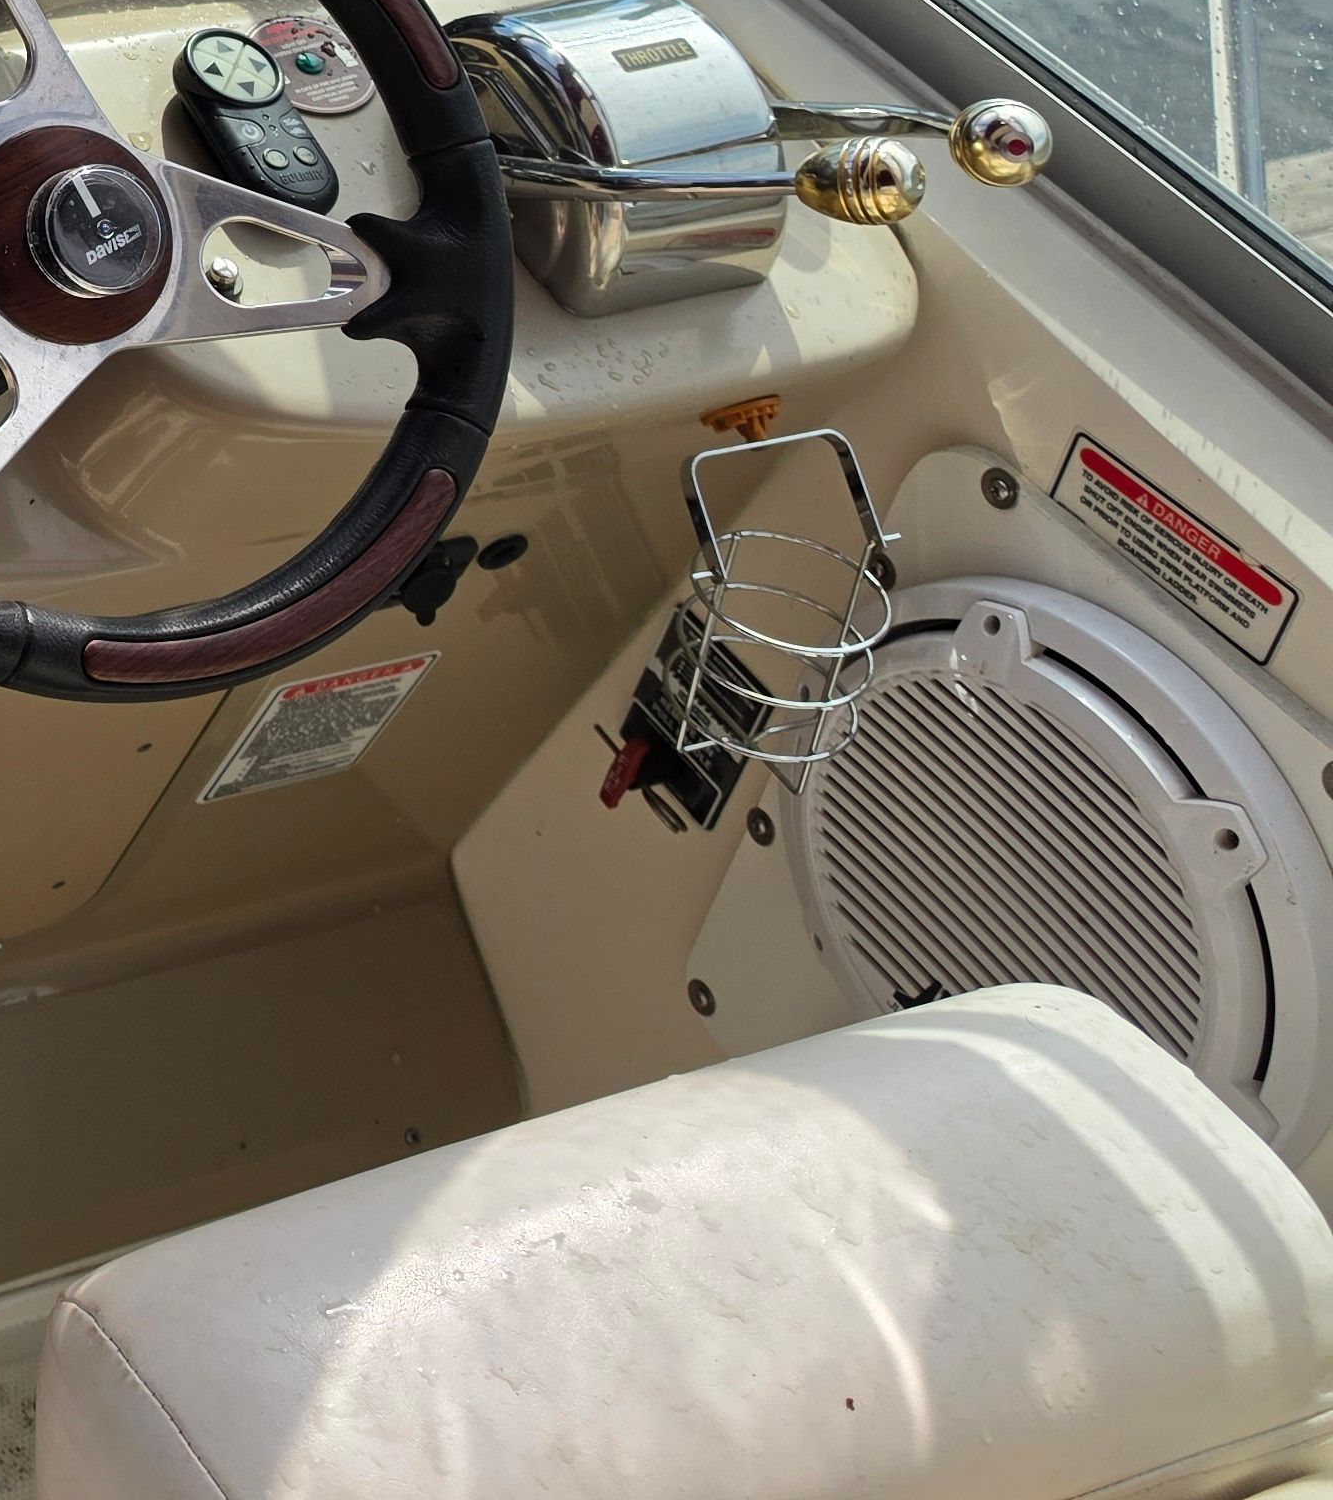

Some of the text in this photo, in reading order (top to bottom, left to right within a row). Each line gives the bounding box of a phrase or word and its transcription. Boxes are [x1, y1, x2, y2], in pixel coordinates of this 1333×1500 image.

[618, 42, 695, 68] THROTTLE
[279, 170, 325, 185] GOLIGHT
[1080, 495, 1250, 630] OR PRIOR TO USING SWIM PLATFORM AND
[1082, 469, 1269, 615] TO AVOID RISK OF SERIOUS INJURY OR DEATH
[1083, 485, 1257, 620] SHUT OFF ENGINE WHEN NEAR SWIMMERS
[1152, 500, 1223, 561] DANGER
[1117, 538, 1199, 606] BOARDING LADDER.
[317, 666, 397, 690] DANGER
